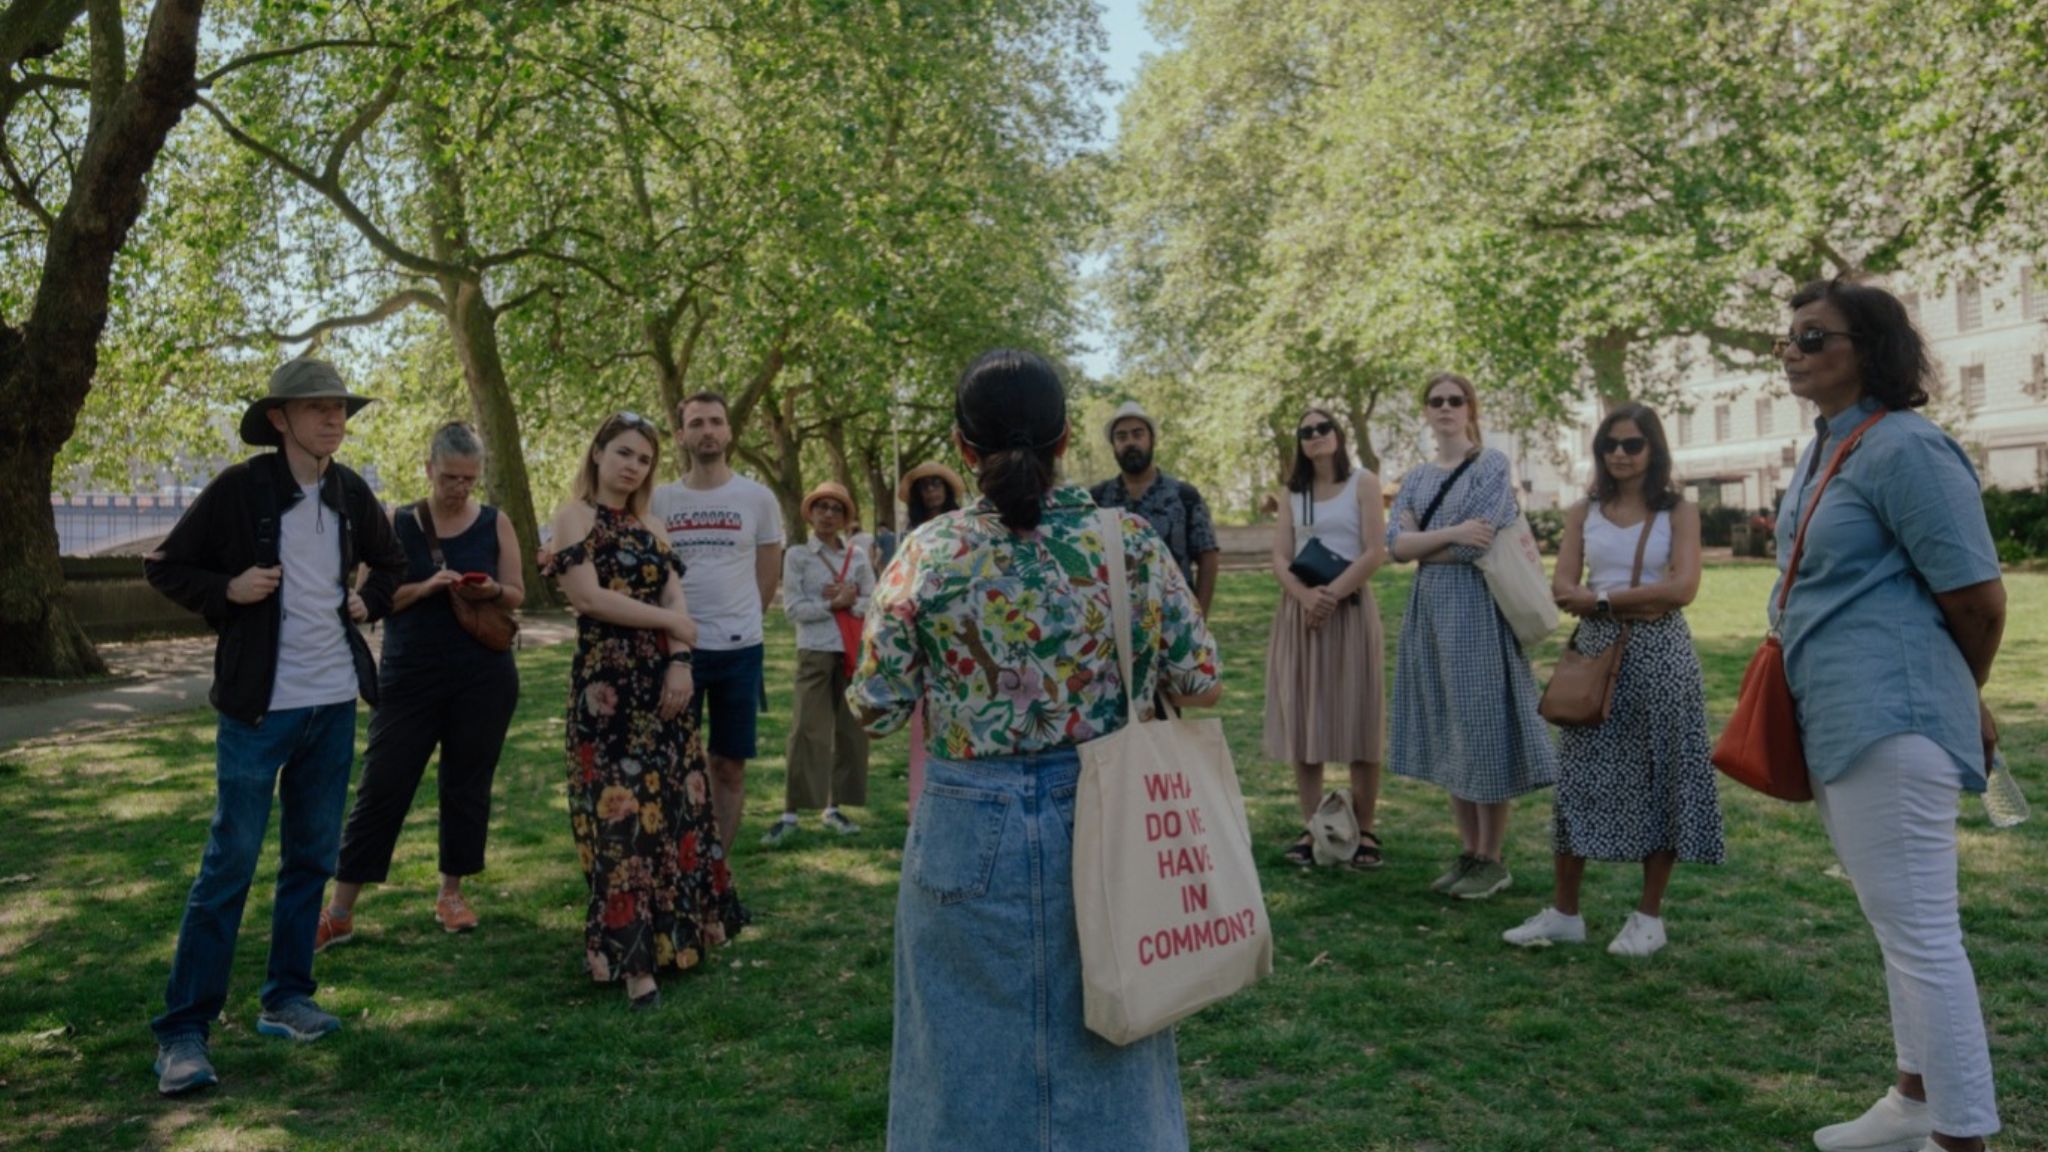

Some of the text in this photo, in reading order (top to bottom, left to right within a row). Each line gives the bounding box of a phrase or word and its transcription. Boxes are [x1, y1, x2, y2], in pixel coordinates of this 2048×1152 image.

[666, 511, 742, 529] LEE COOPER
[1145, 811, 1182, 841] DO
[1181, 883, 1208, 914] IN
[1138, 908, 1256, 966] COMMON?
